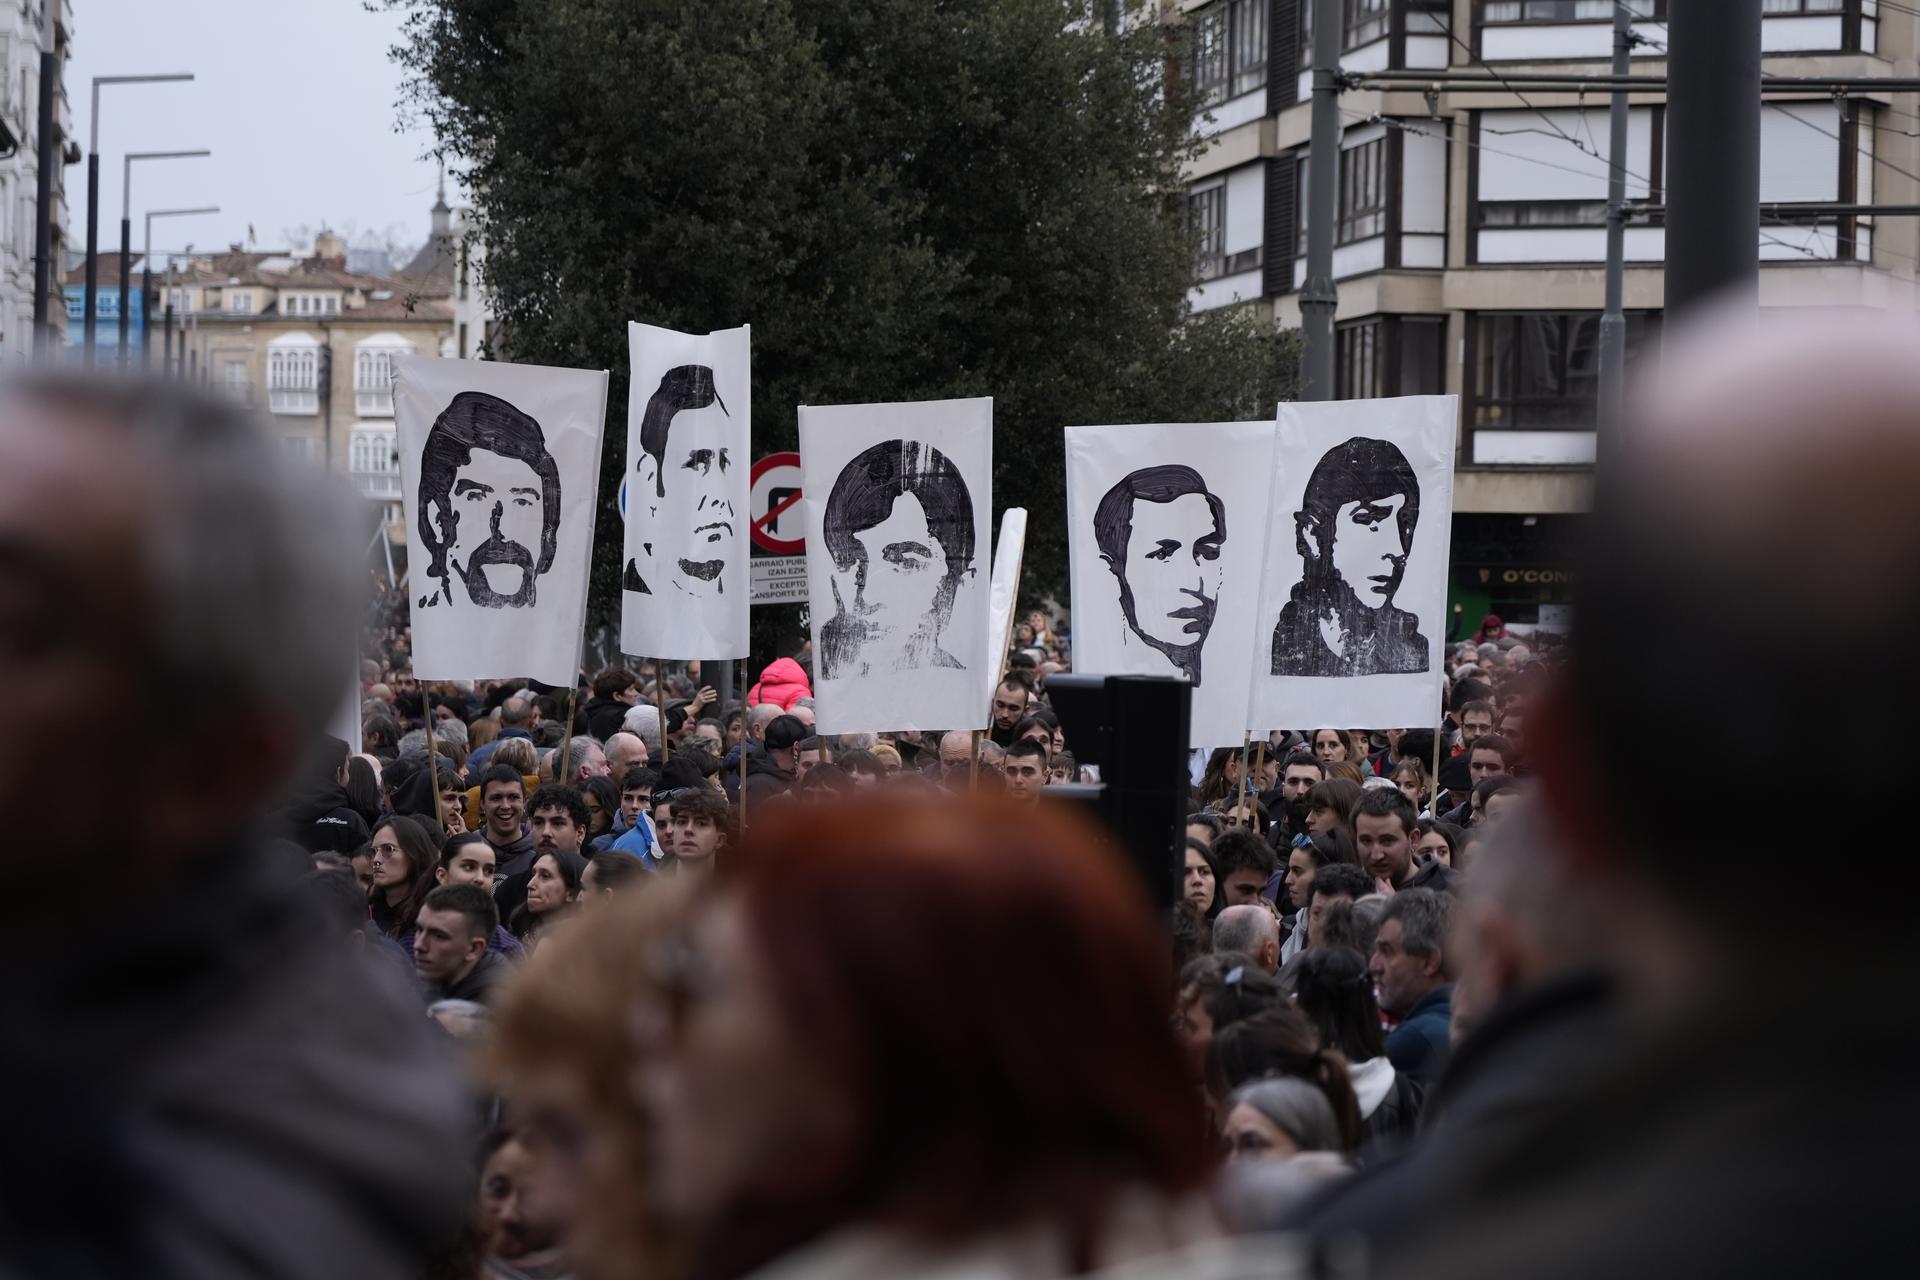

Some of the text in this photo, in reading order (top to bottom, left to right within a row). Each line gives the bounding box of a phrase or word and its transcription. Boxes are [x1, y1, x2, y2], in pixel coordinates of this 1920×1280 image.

[768, 567, 806, 576] IZAN EZIK
[770, 580, 806, 589] EXCEPTO
[751, 591, 796, 599] ANSPORTE
